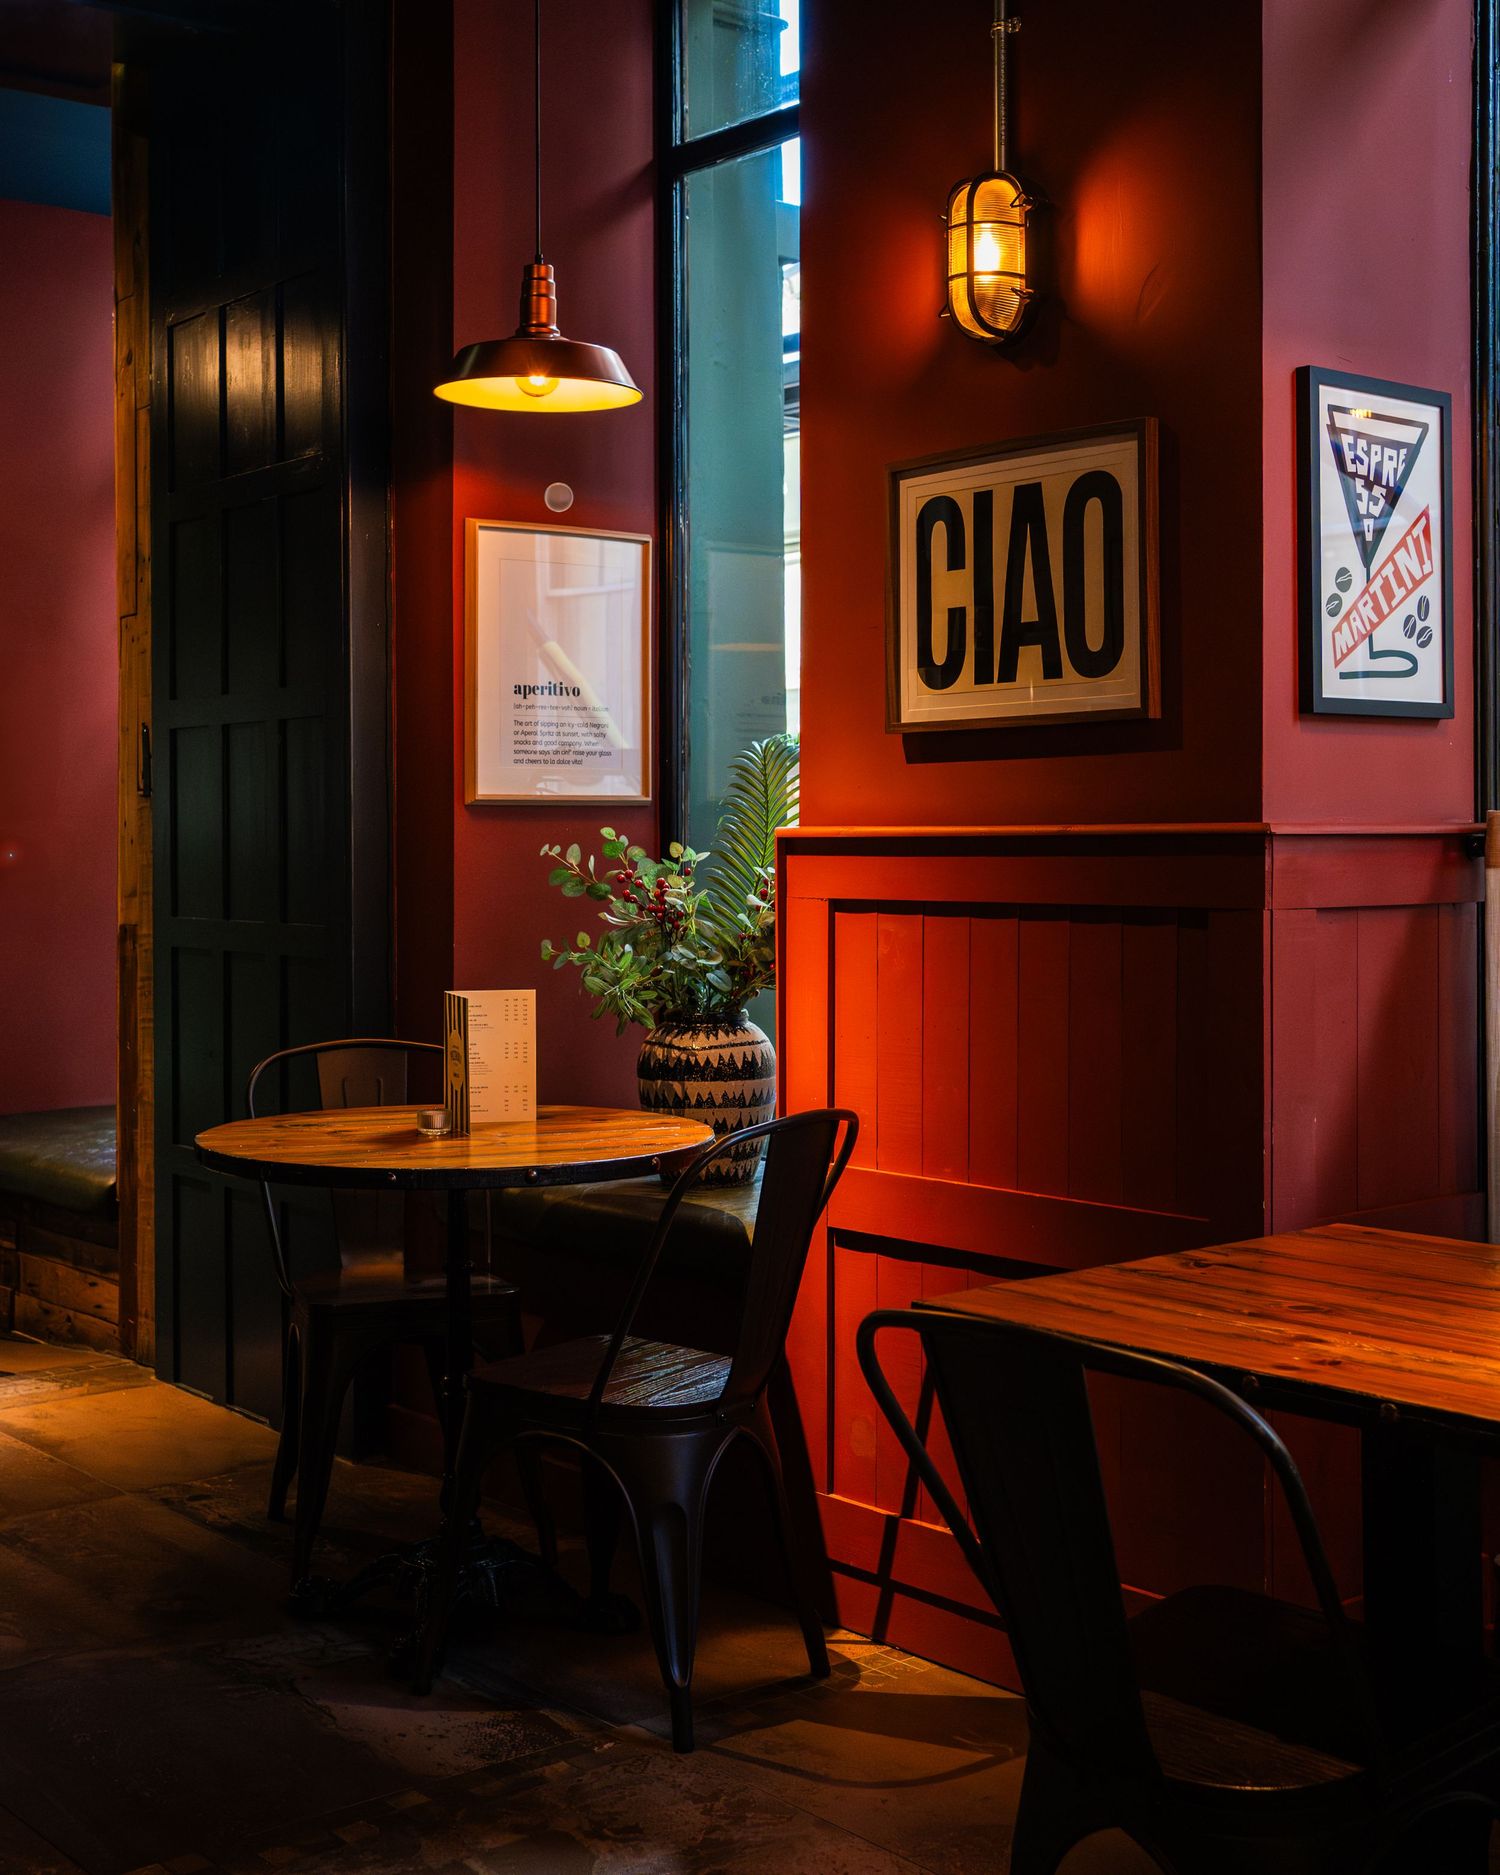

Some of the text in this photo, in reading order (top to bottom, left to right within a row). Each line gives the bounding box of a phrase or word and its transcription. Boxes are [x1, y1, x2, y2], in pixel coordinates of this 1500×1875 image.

[1340, 433, 1407, 488] ESPRE
[1355, 477, 1387, 517] SS
[1363, 518, 1373, 541] O
[916, 470, 1124, 690] CIAO
[1334, 516, 1433, 662] MARTINI
[513, 681, 580, 700] aperitivo
[520, 729, 538, 737] Aperol
[598, 750, 612, 758] glass
